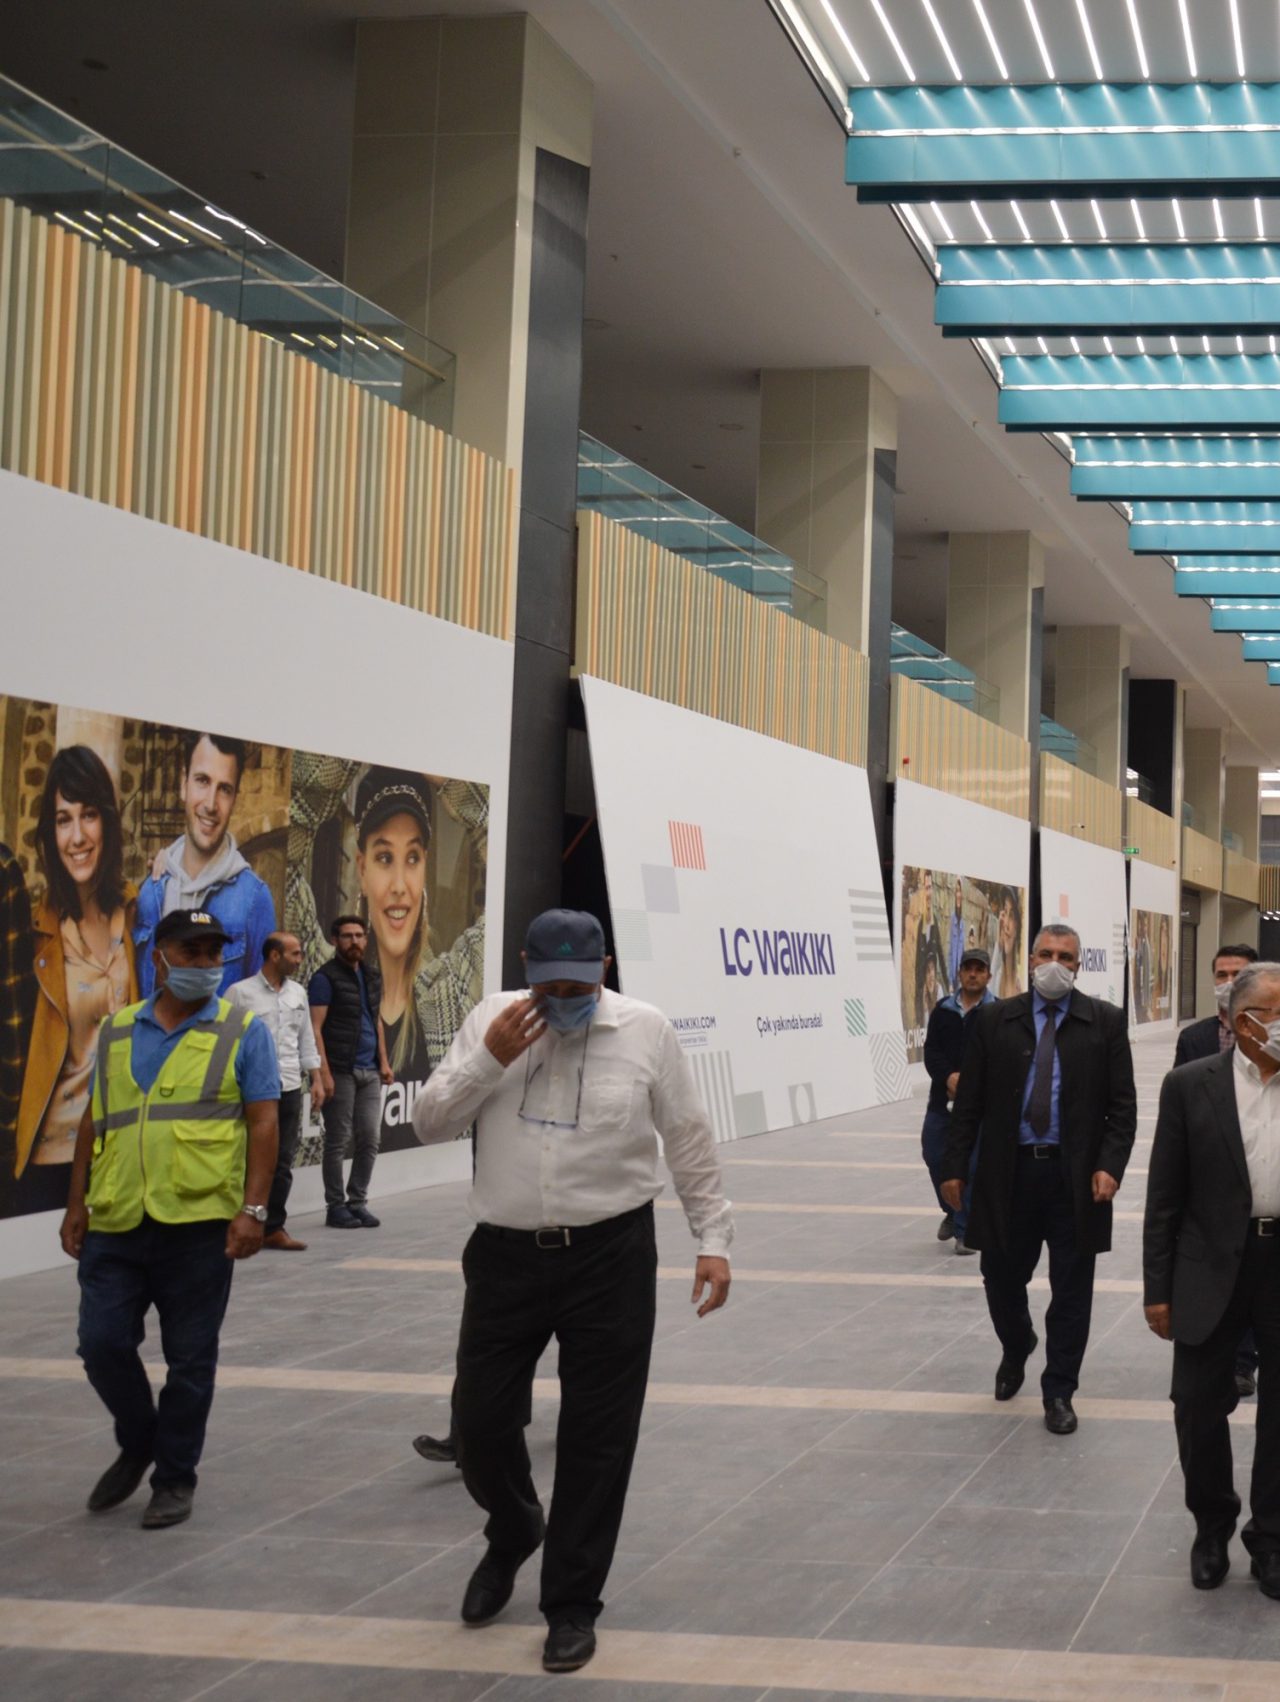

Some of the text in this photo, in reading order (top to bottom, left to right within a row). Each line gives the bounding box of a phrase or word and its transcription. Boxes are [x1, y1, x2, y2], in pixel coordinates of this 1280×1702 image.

[720, 927, 753, 976] LC
[669, 1015, 717, 1031] WAIKIKI.COM
[756, 1015, 772, 1038] Çok
[799, 1012, 823, 1030] burada!
